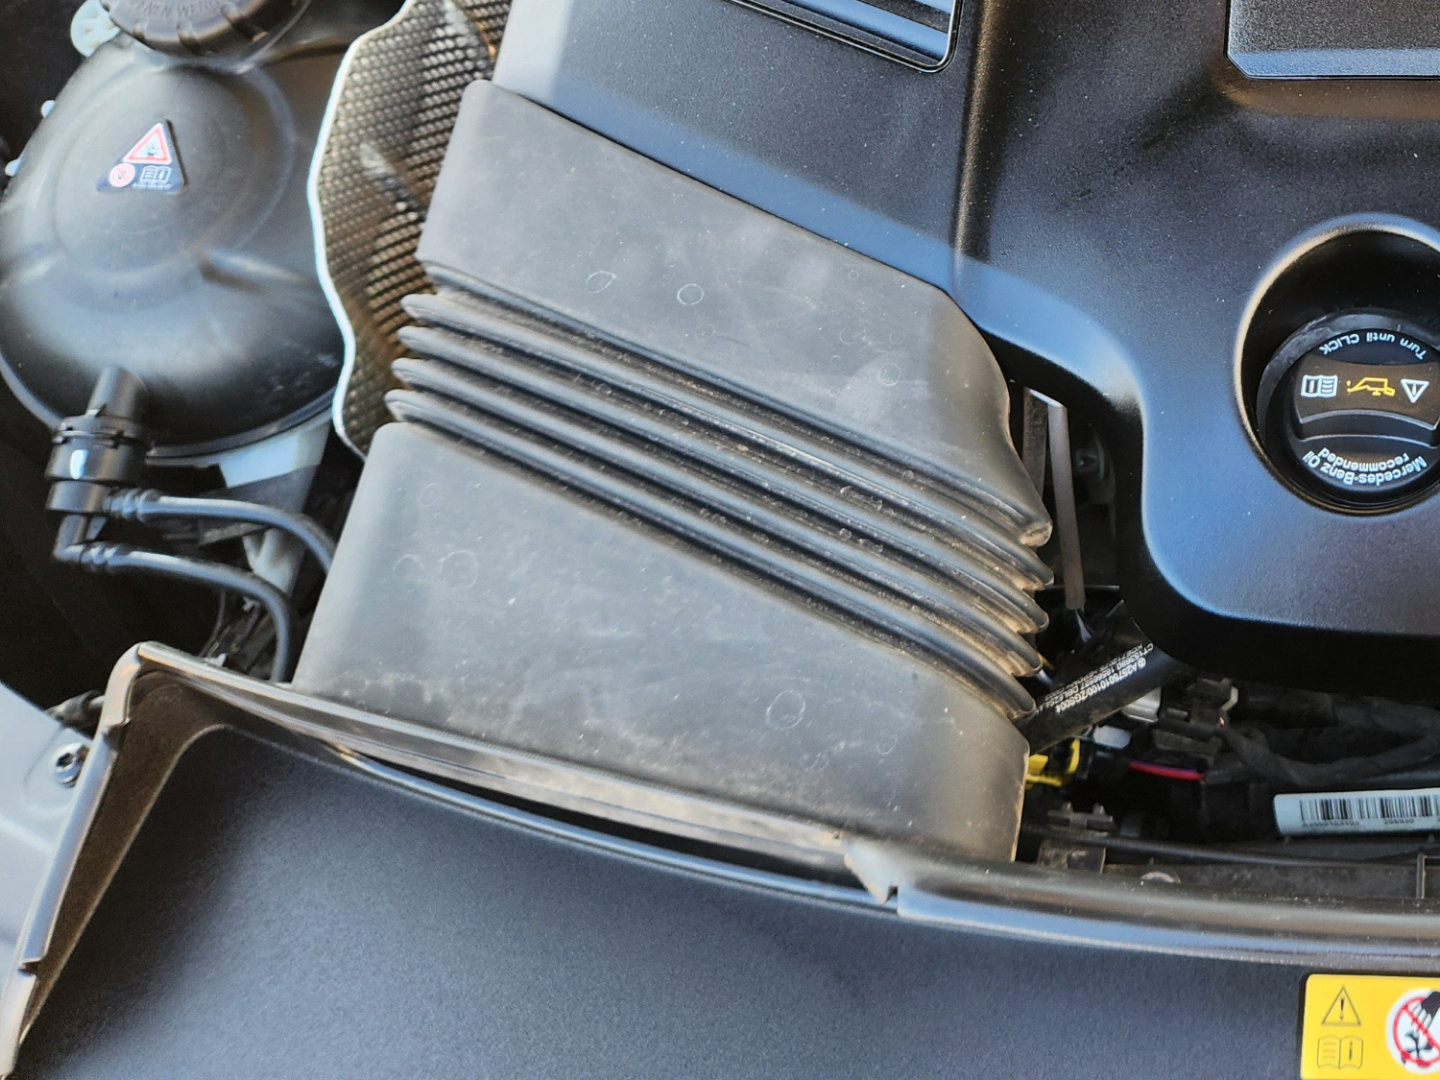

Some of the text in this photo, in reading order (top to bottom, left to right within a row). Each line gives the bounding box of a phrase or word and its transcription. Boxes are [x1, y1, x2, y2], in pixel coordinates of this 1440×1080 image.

[1318, 332, 1428, 360] Turn until CLICK
[1302, 449, 1429, 486] Mercedes-Benz Oil
[1316, 447, 1410, 472] recommended
